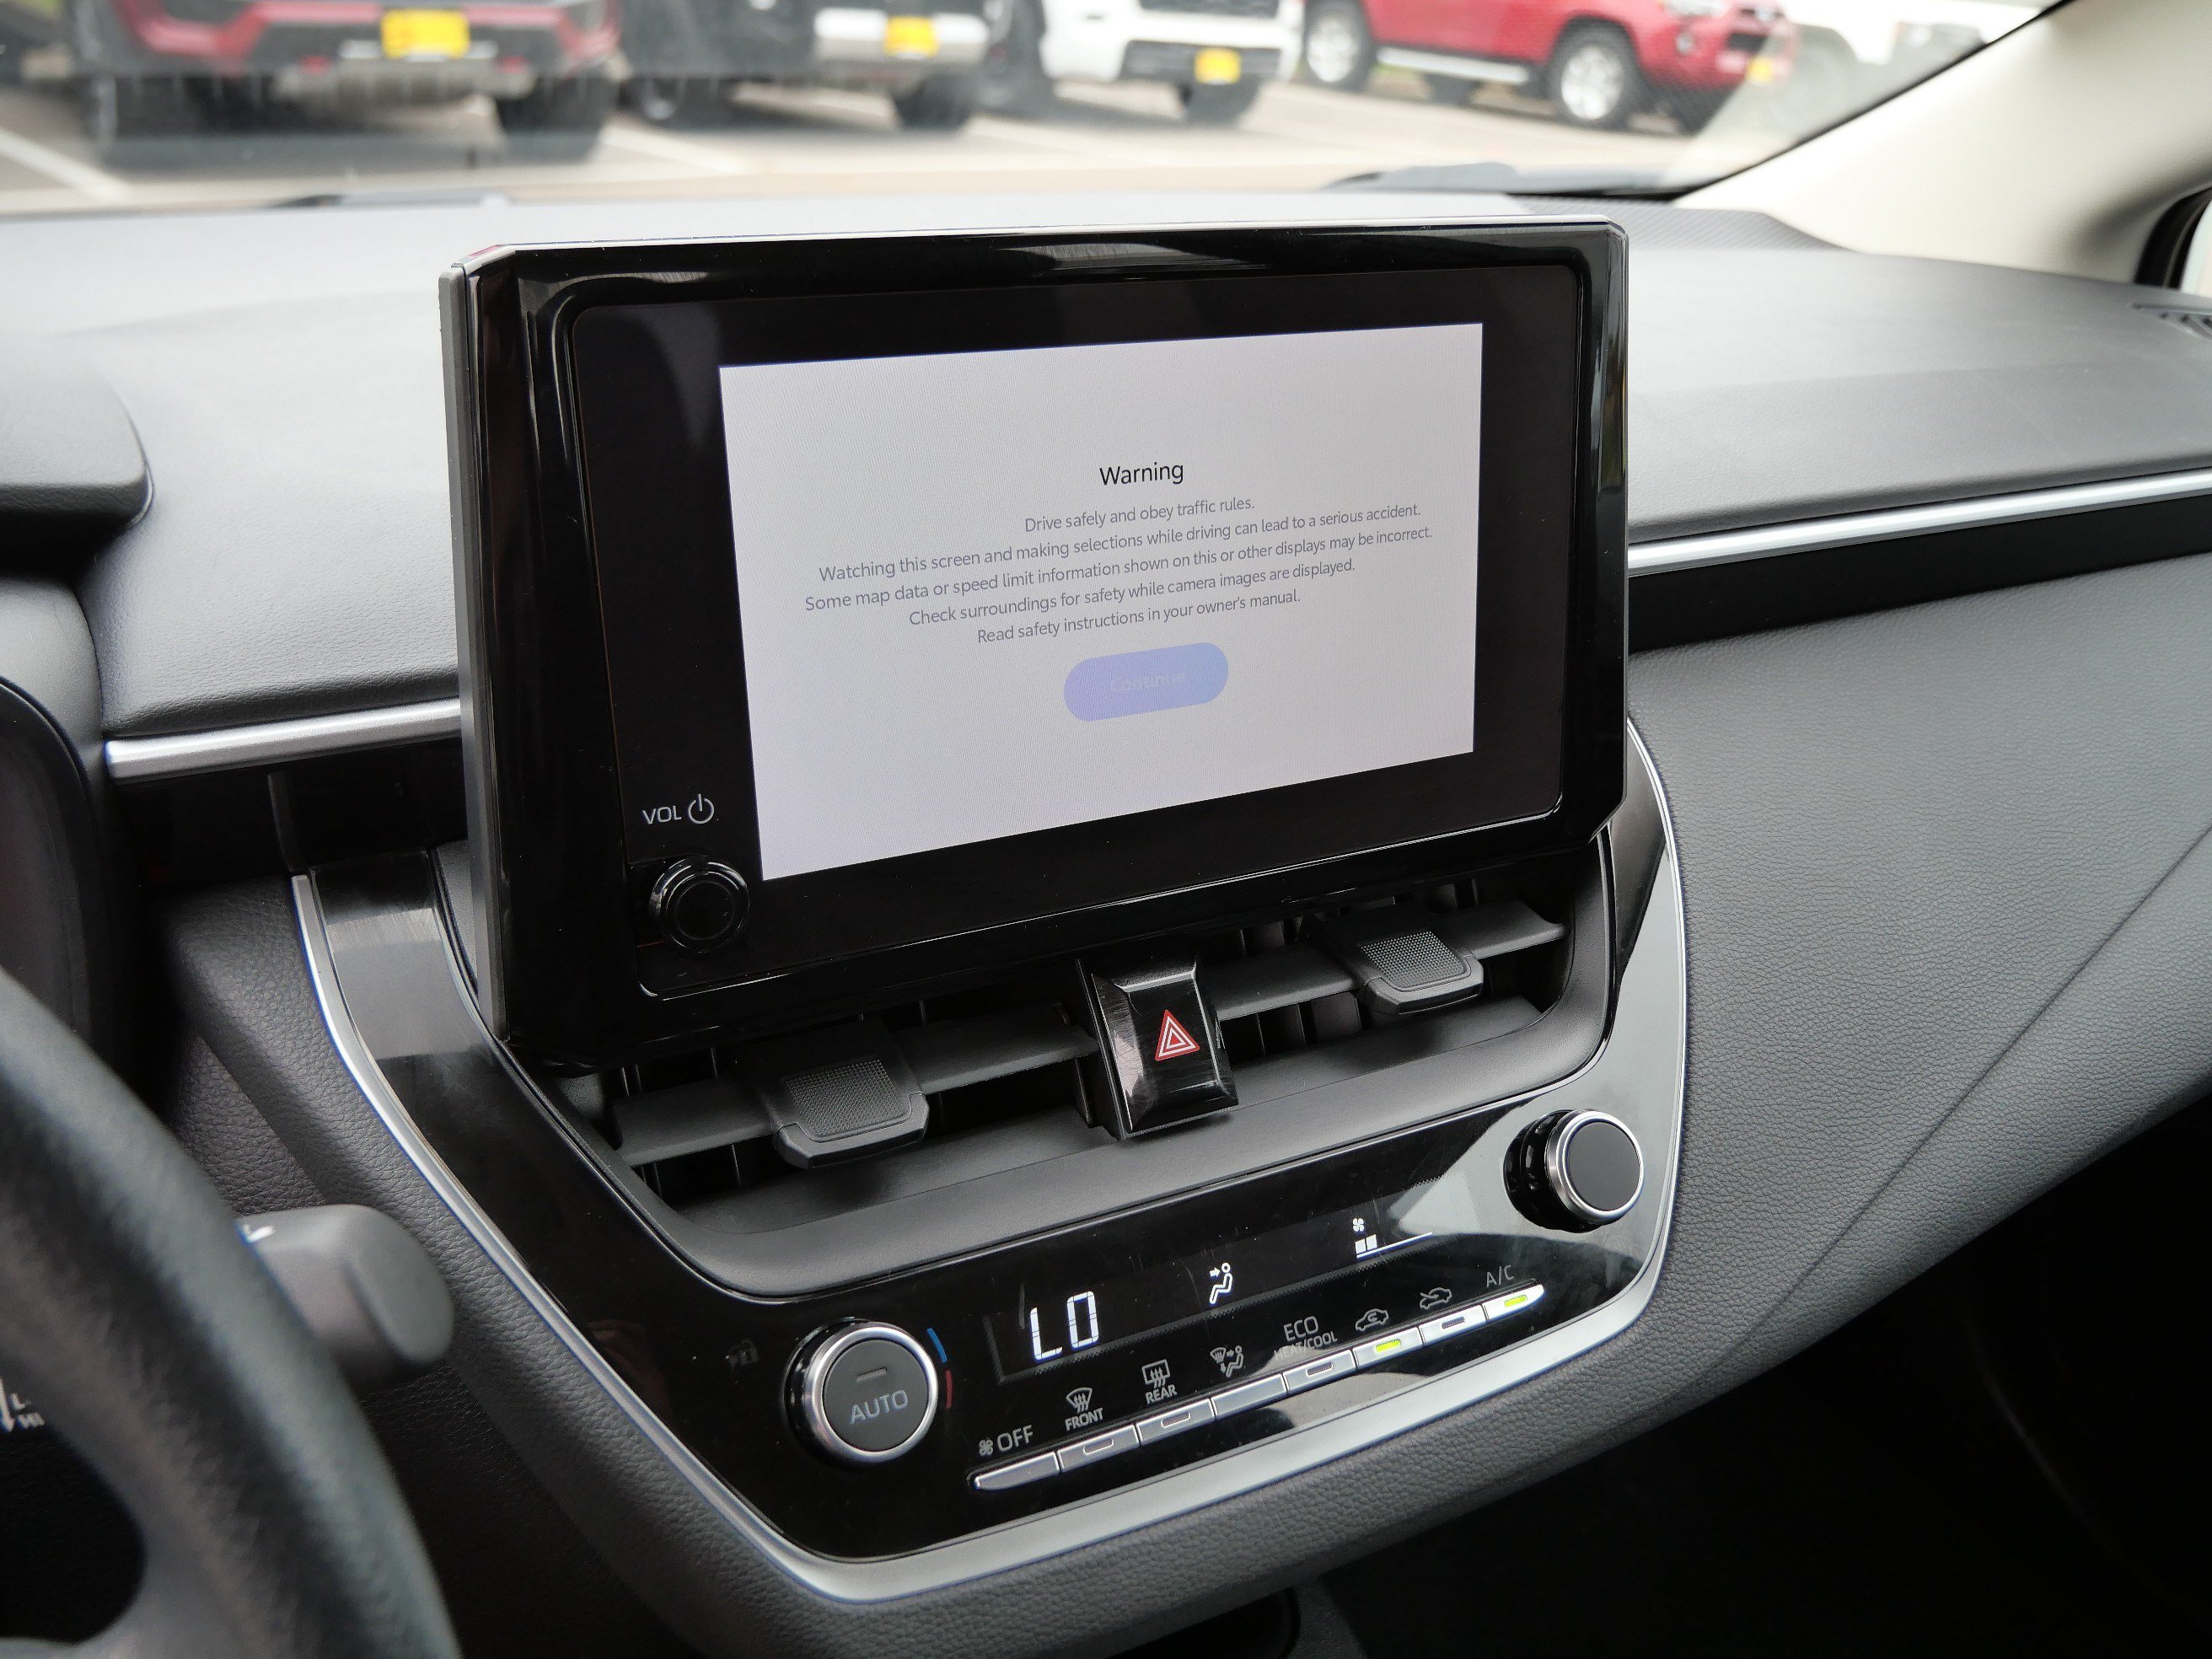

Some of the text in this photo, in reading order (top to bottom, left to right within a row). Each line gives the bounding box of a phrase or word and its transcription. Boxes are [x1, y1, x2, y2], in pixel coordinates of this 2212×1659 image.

[1098, 460, 1184, 487] Warning
[1023, 496, 1256, 534] Drive safely and obey traffic rules.
[818, 502, 1422, 583] Watching this screen and making selections while driving can lead to a serious accident.
[804, 525, 1433, 612] Some map data or speed limit information shown on this or other displays may be incorrect.
[908, 556, 1356, 626] Check surroundings for safety while camera images are displayed.
[976, 588, 1302, 645] Read safety instructions in your owner's manual.
[642, 805, 682, 824] VOL
[1486, 1264, 1515, 1288] A/C
[1283, 1316, 1319, 1342] ECO
[1274, 1331, 1338, 1361] HEAT/COOL
[851, 1389, 909, 1425] AUTO
[1146, 1383, 1178, 1404] REAR
[1065, 1407, 1103, 1431] FRONT
[996, 1425, 1034, 1452] OFF
